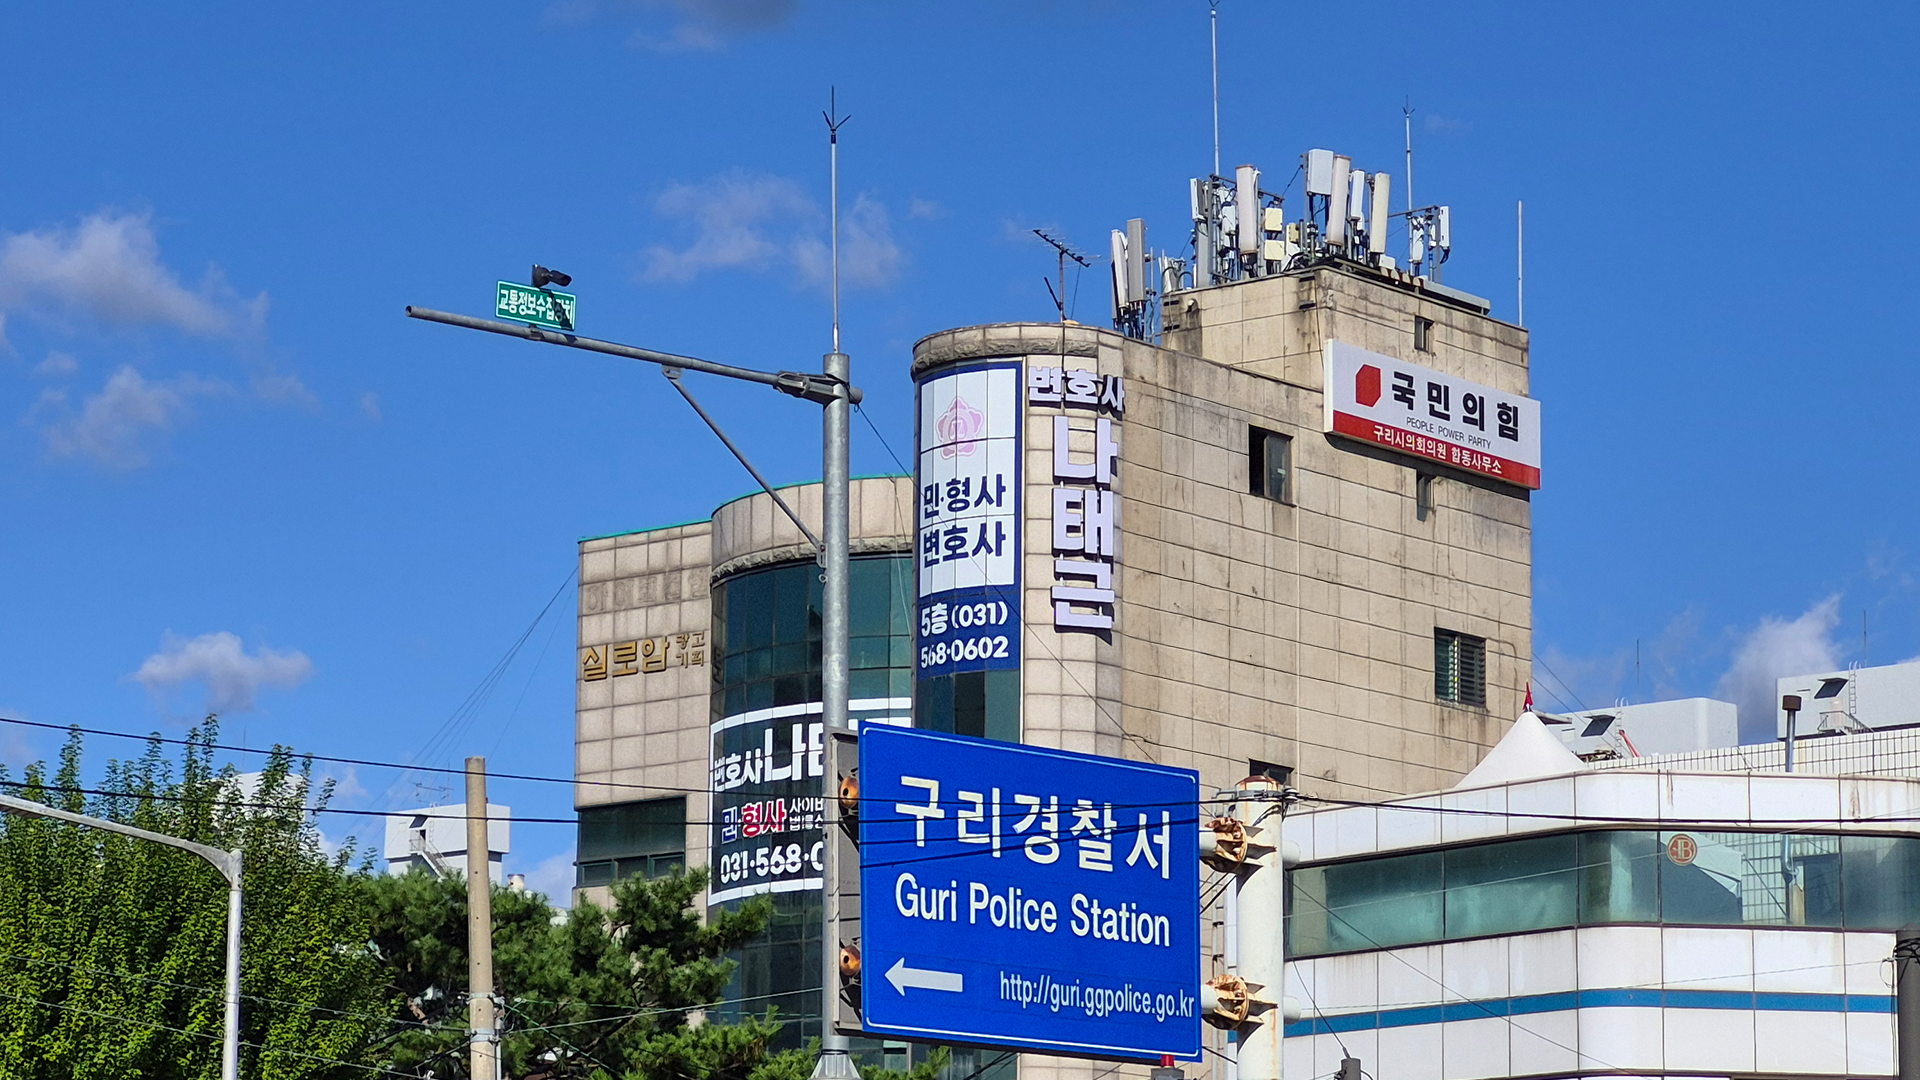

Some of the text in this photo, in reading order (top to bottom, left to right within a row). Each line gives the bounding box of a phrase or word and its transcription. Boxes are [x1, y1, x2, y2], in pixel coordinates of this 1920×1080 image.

[1028, 366, 1125, 412] 변호사
[1391, 371, 1519, 442] 국민의힘
[1373, 425, 1503, 474] 구리시의회의원 합동사무소
[1406, 416, 1491, 450] PEOPLE POWER PARTY
[923, 521, 1007, 569] 변호사
[1051, 415, 1118, 630] 나태근
[583, 636, 671, 682] 실로암
[714, 748, 763, 792] 변호사
[895, 775, 1170, 880] 구리경찰서
[895, 872, 1170, 947] Guri Police Station
[1000, 970, 1195, 1023] http://guri.ggpolice.go.kr
